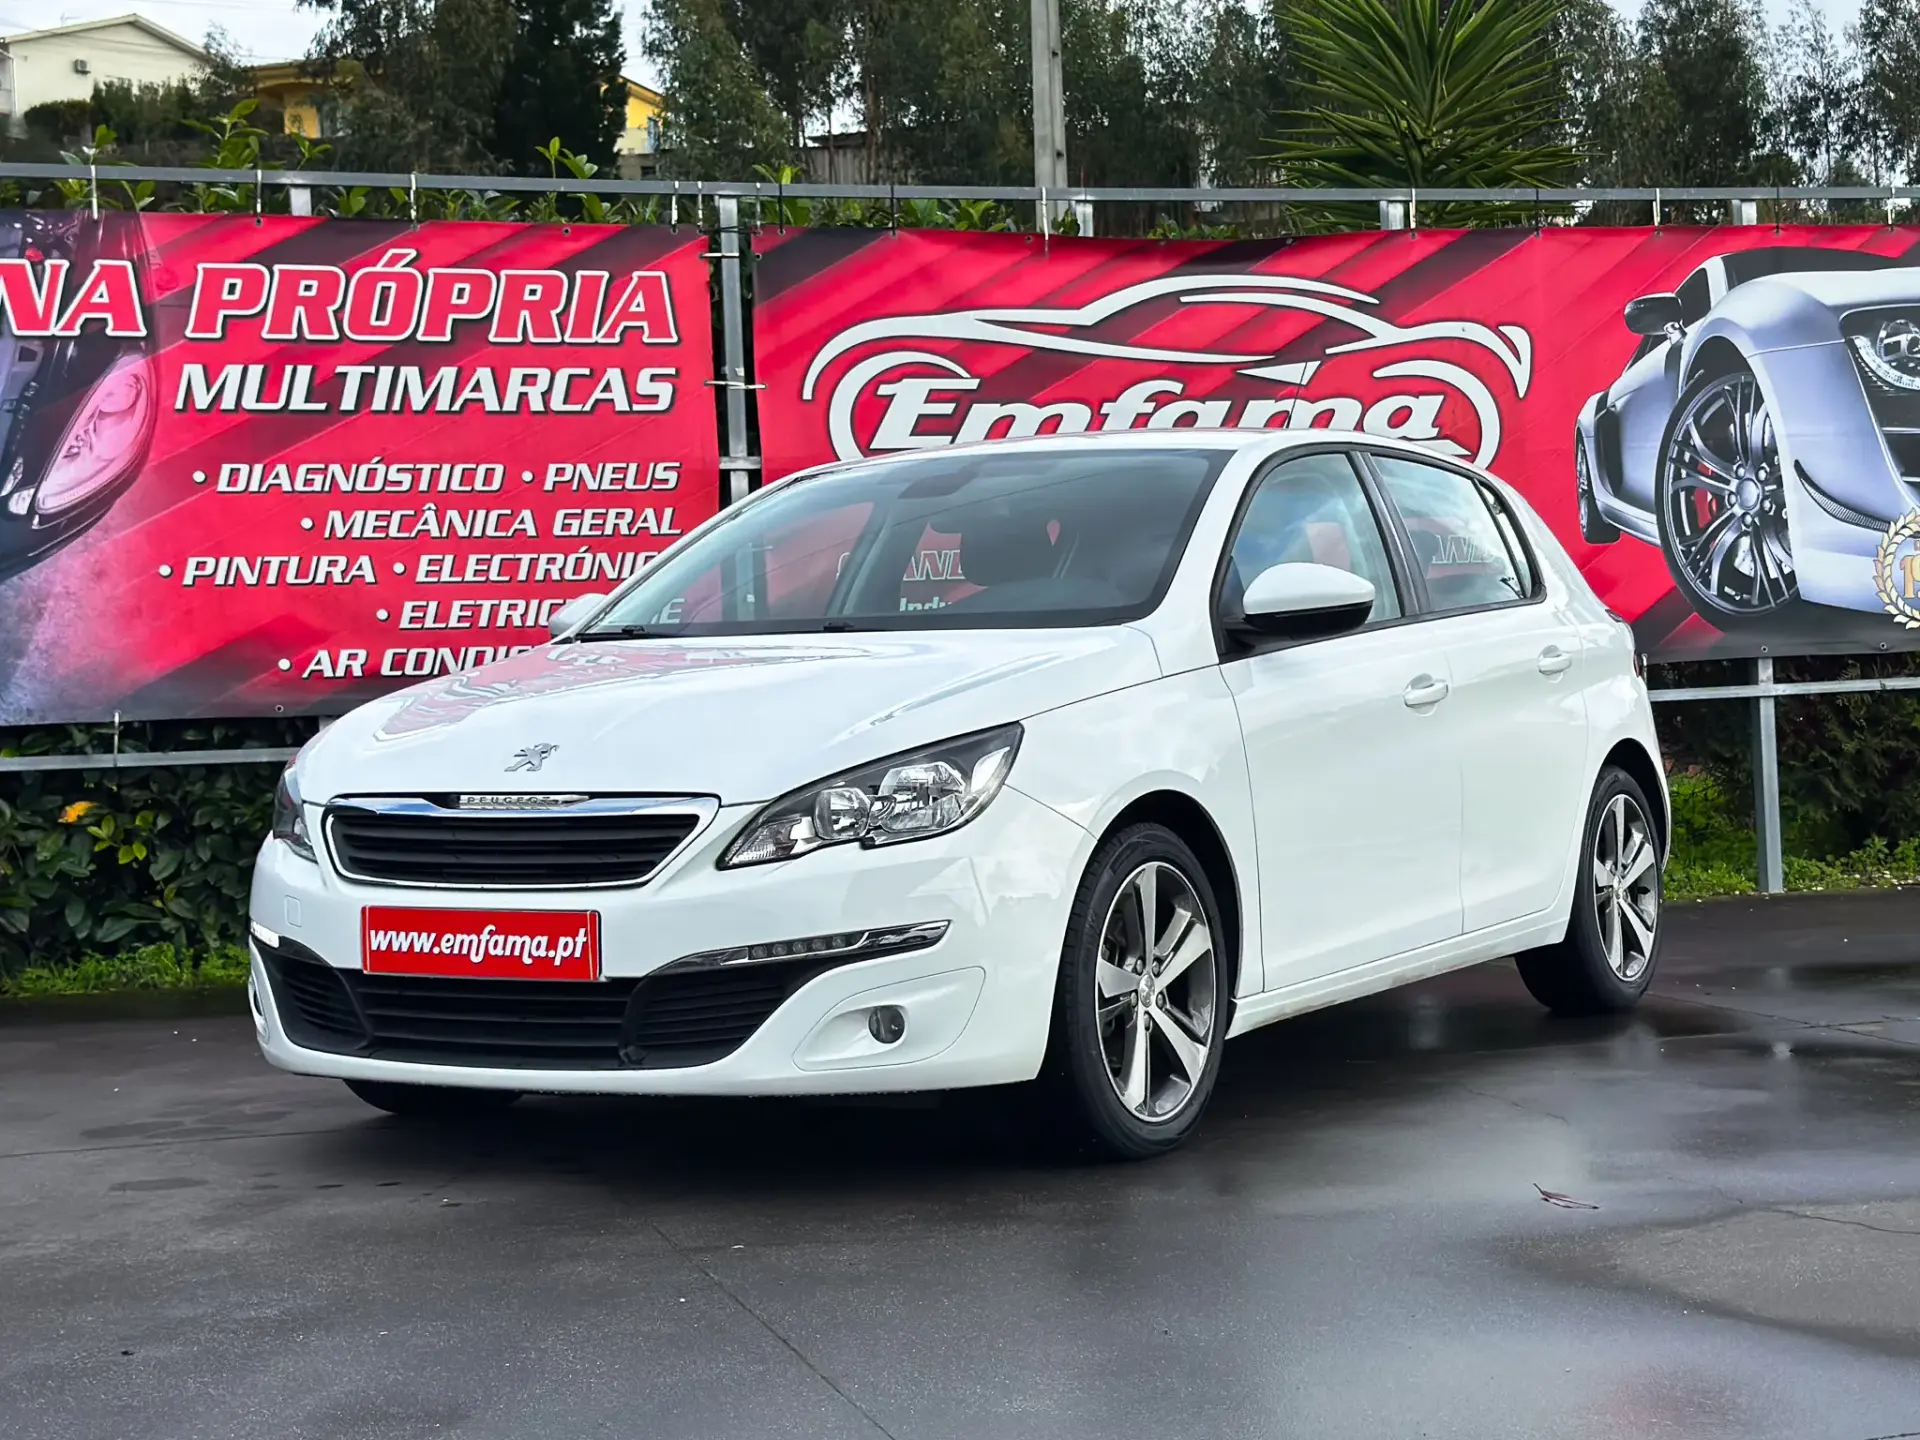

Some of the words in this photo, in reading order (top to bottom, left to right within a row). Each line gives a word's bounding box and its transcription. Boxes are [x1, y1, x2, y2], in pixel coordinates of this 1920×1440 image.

[185, 249, 679, 343] PRÓPRIA
[175, 364, 676, 412] MULTIMARCAS
[868, 377, 1446, 450] Emfama
[217, 457, 504, 492] DIAGNÓSTICO
[544, 461, 681, 491] PNEUS
[323, 503, 537, 539] MECÂNICA
[552, 507, 682, 536] GERAL
[182, 555, 376, 585] PINTURA
[302, 648, 367, 678] AR
[369, 924, 588, 966] www.emfama.pt
